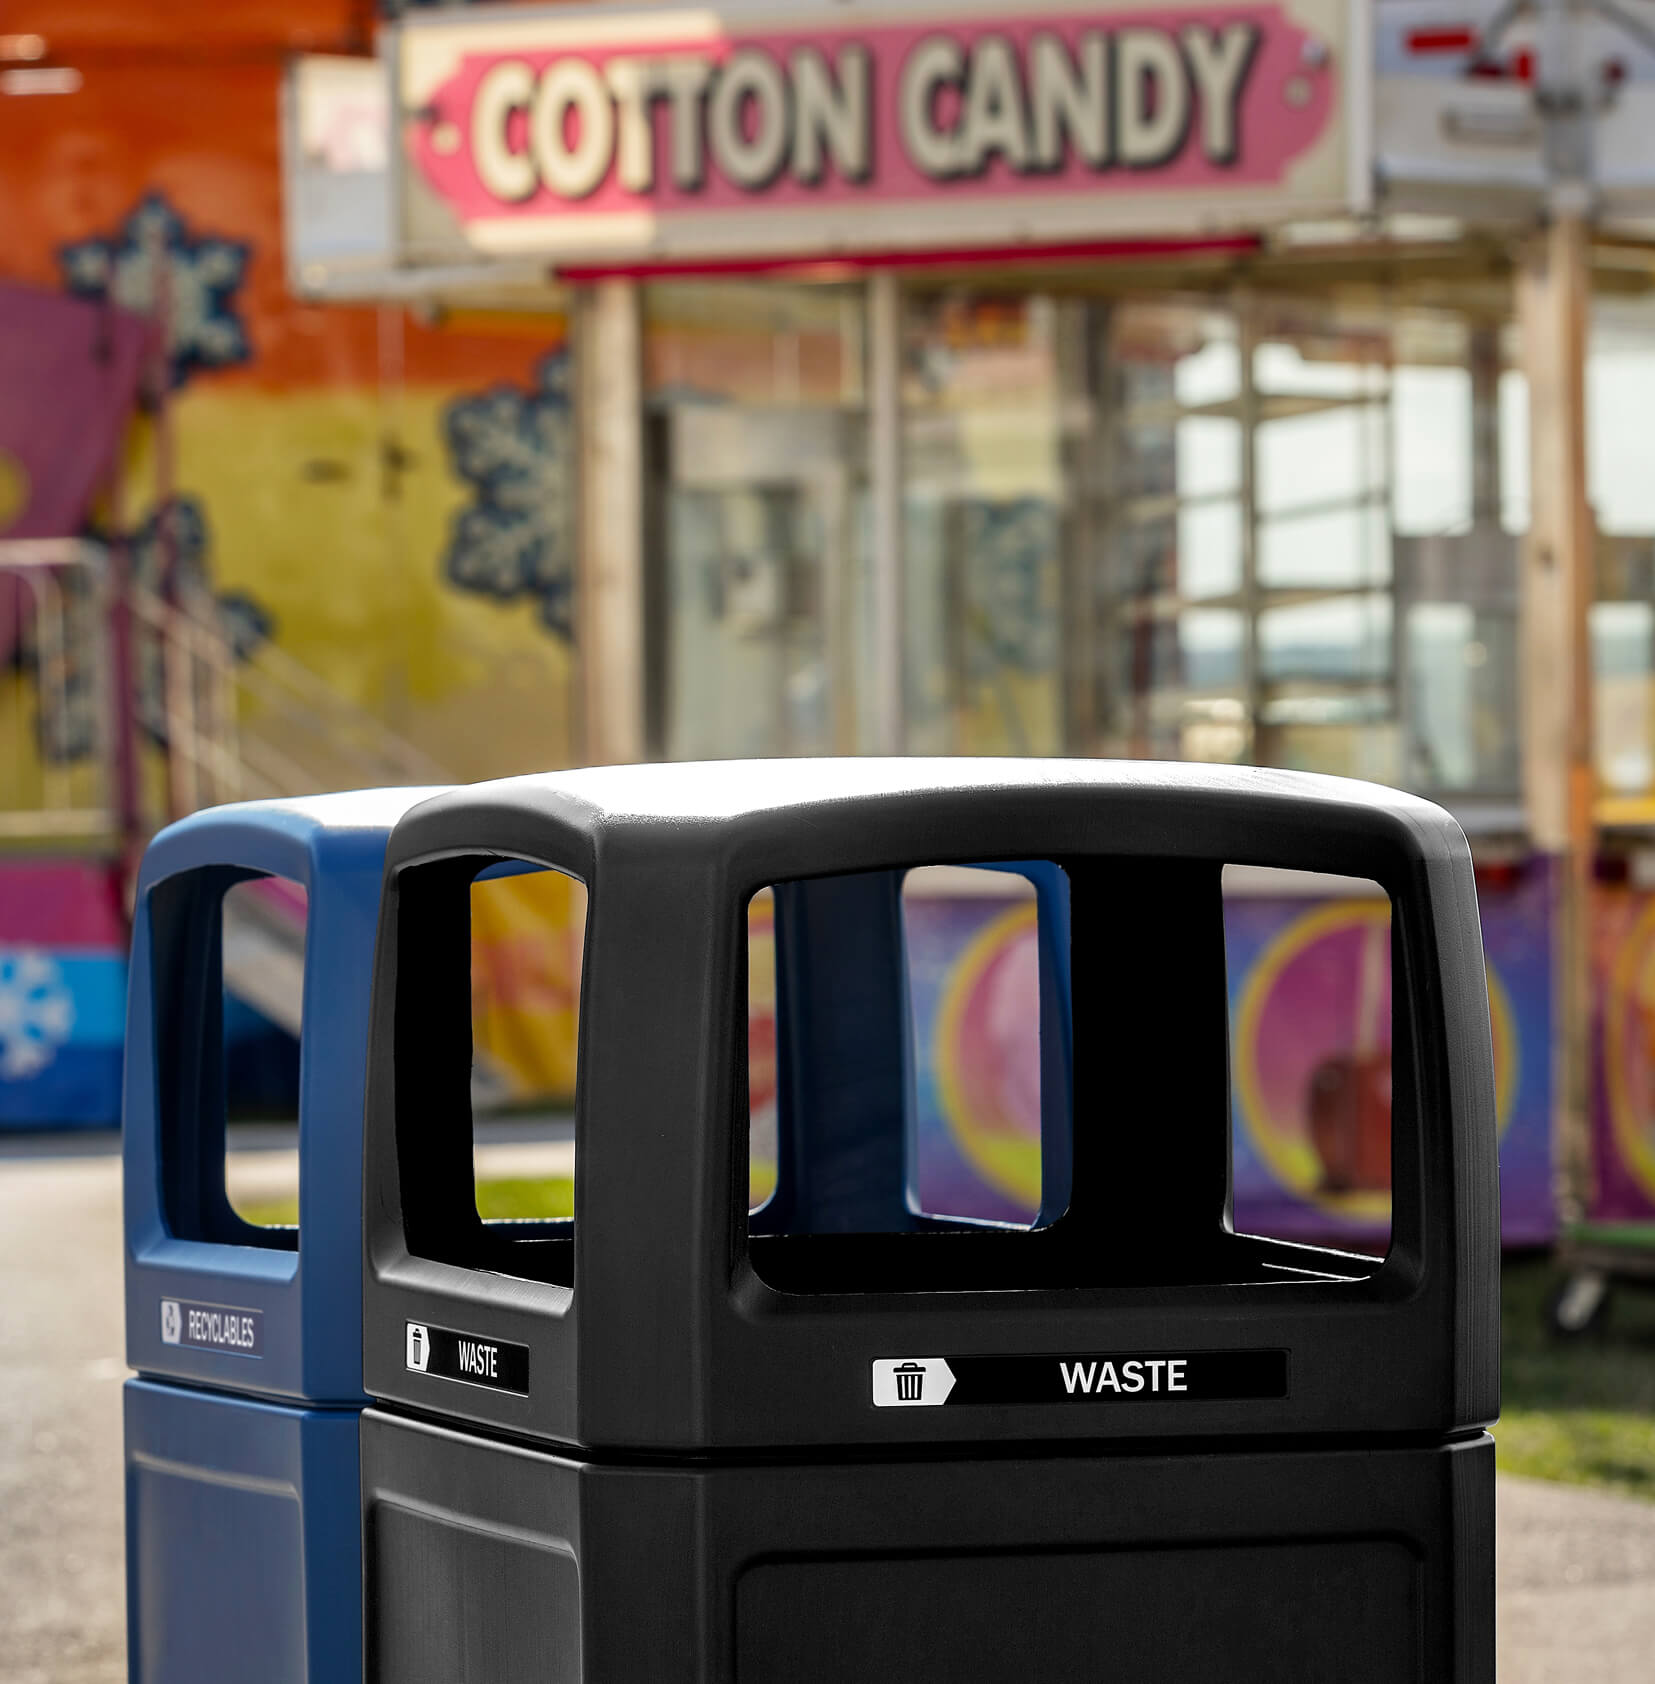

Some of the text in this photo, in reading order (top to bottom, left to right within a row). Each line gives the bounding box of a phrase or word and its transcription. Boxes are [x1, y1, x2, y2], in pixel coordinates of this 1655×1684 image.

[470, 22, 1260, 202] COTTON CANDY
[188, 1310, 255, 1348] RECYCLABLES
[458, 1340, 498, 1378] WASTE
[1060, 1360, 1188, 1394] WASTE
